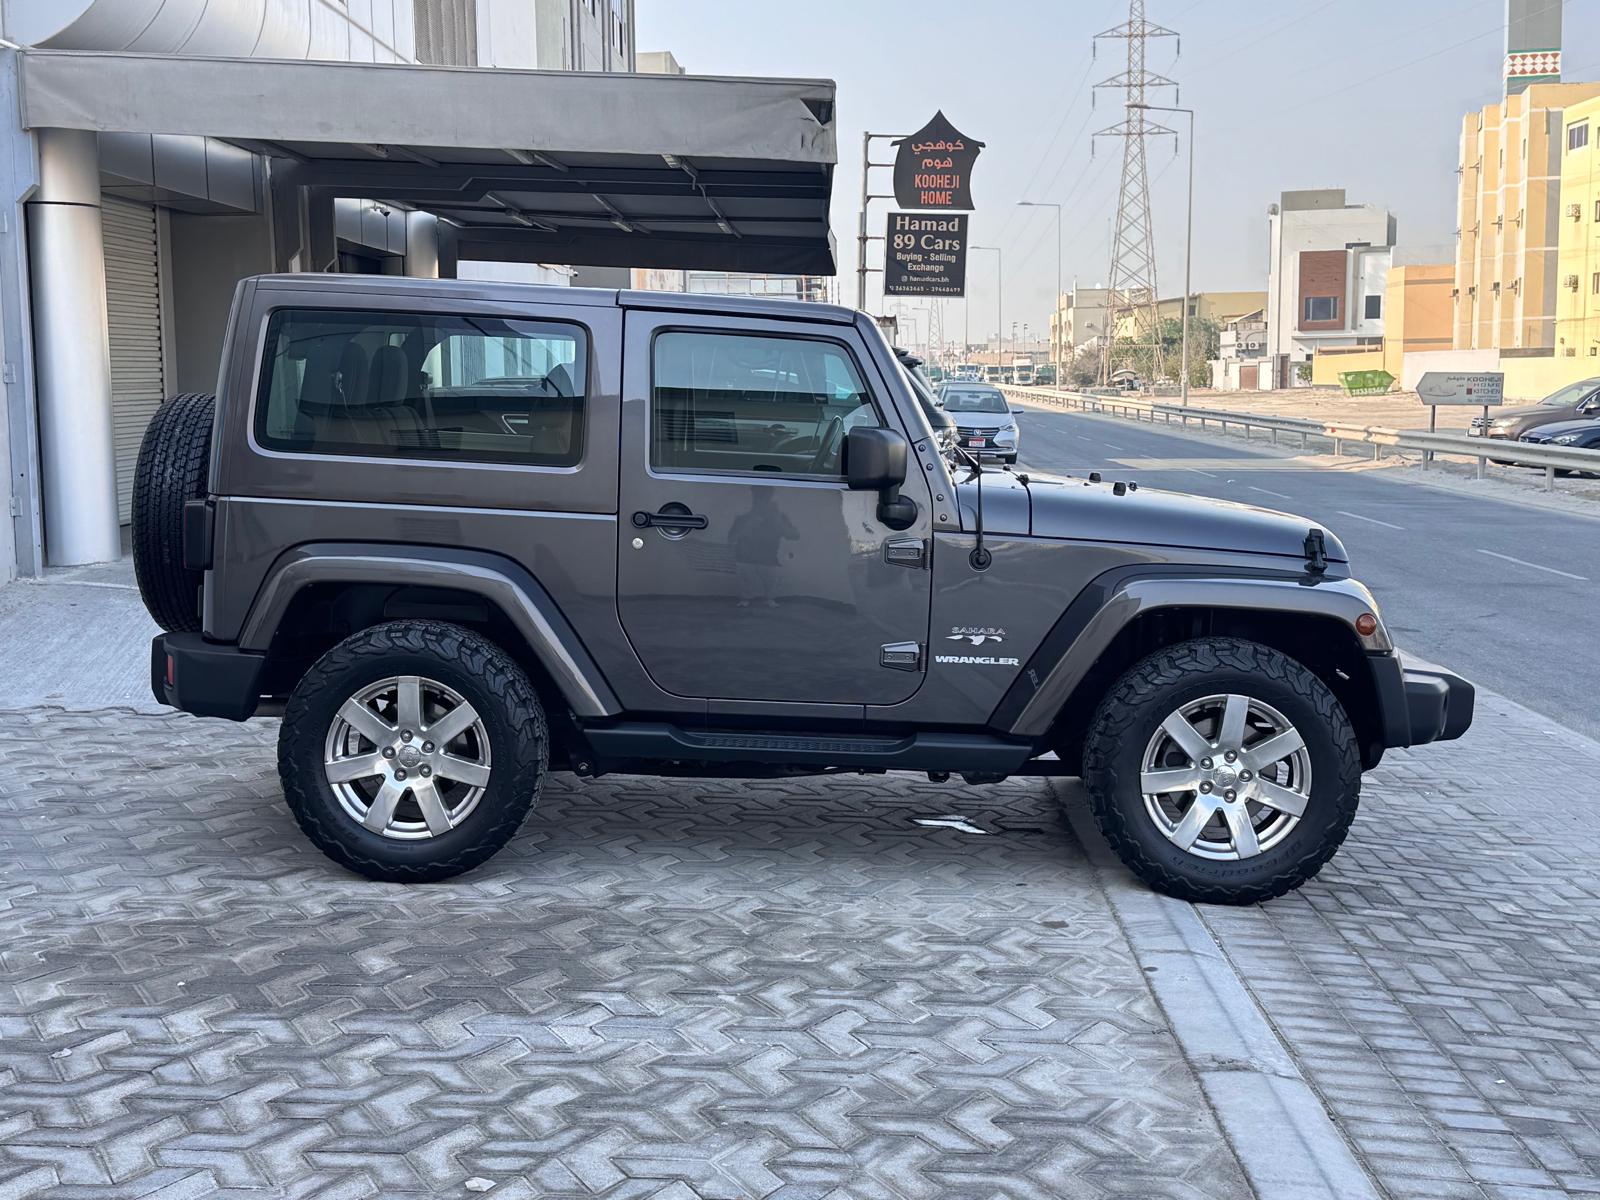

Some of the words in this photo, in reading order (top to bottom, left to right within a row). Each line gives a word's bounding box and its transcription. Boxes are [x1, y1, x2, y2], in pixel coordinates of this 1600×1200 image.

[911, 139, 965, 155] كوهجي
[921, 156, 953, 170] هوم
[914, 174, 960, 189] KOOHEJI
[920, 191, 953, 205] HOME
[895, 216, 959, 232] Hamad
[893, 233, 915, 250] 89
[920, 234, 961, 251] Cars
[896, 252, 922, 262] Buying
[930, 253, 956, 263] Selling
[907, 263, 944, 273] Exchange
[951, 626, 1006, 635] SAHARA
[935, 655, 1020, 666] WRANGLER
